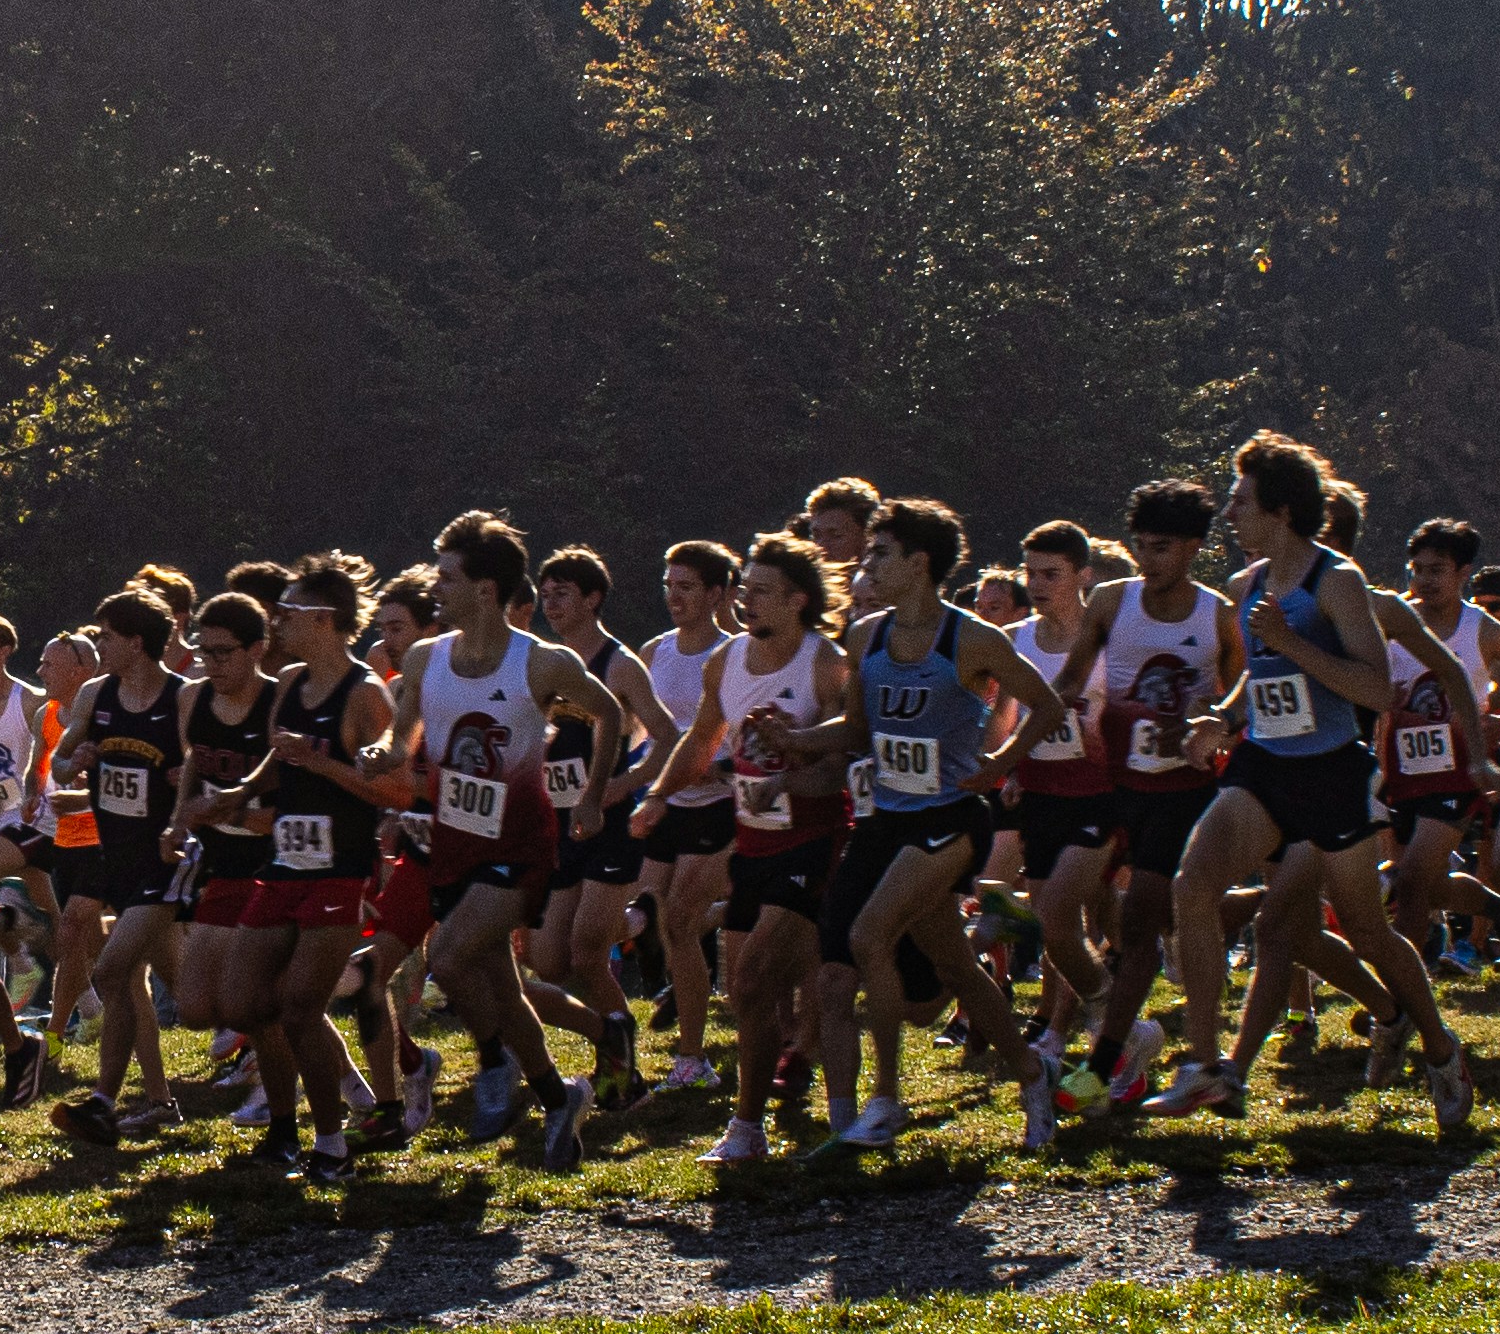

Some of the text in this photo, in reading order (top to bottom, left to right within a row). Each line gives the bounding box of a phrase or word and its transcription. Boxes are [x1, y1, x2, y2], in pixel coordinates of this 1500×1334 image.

[1255, 681, 1299, 717] 459
[883, 739, 927, 775] 460
[1402, 729, 1445, 759] 305
[102, 769, 139, 801] 265
[544, 763, 580, 793] 264
[448, 776, 496, 817] 300
